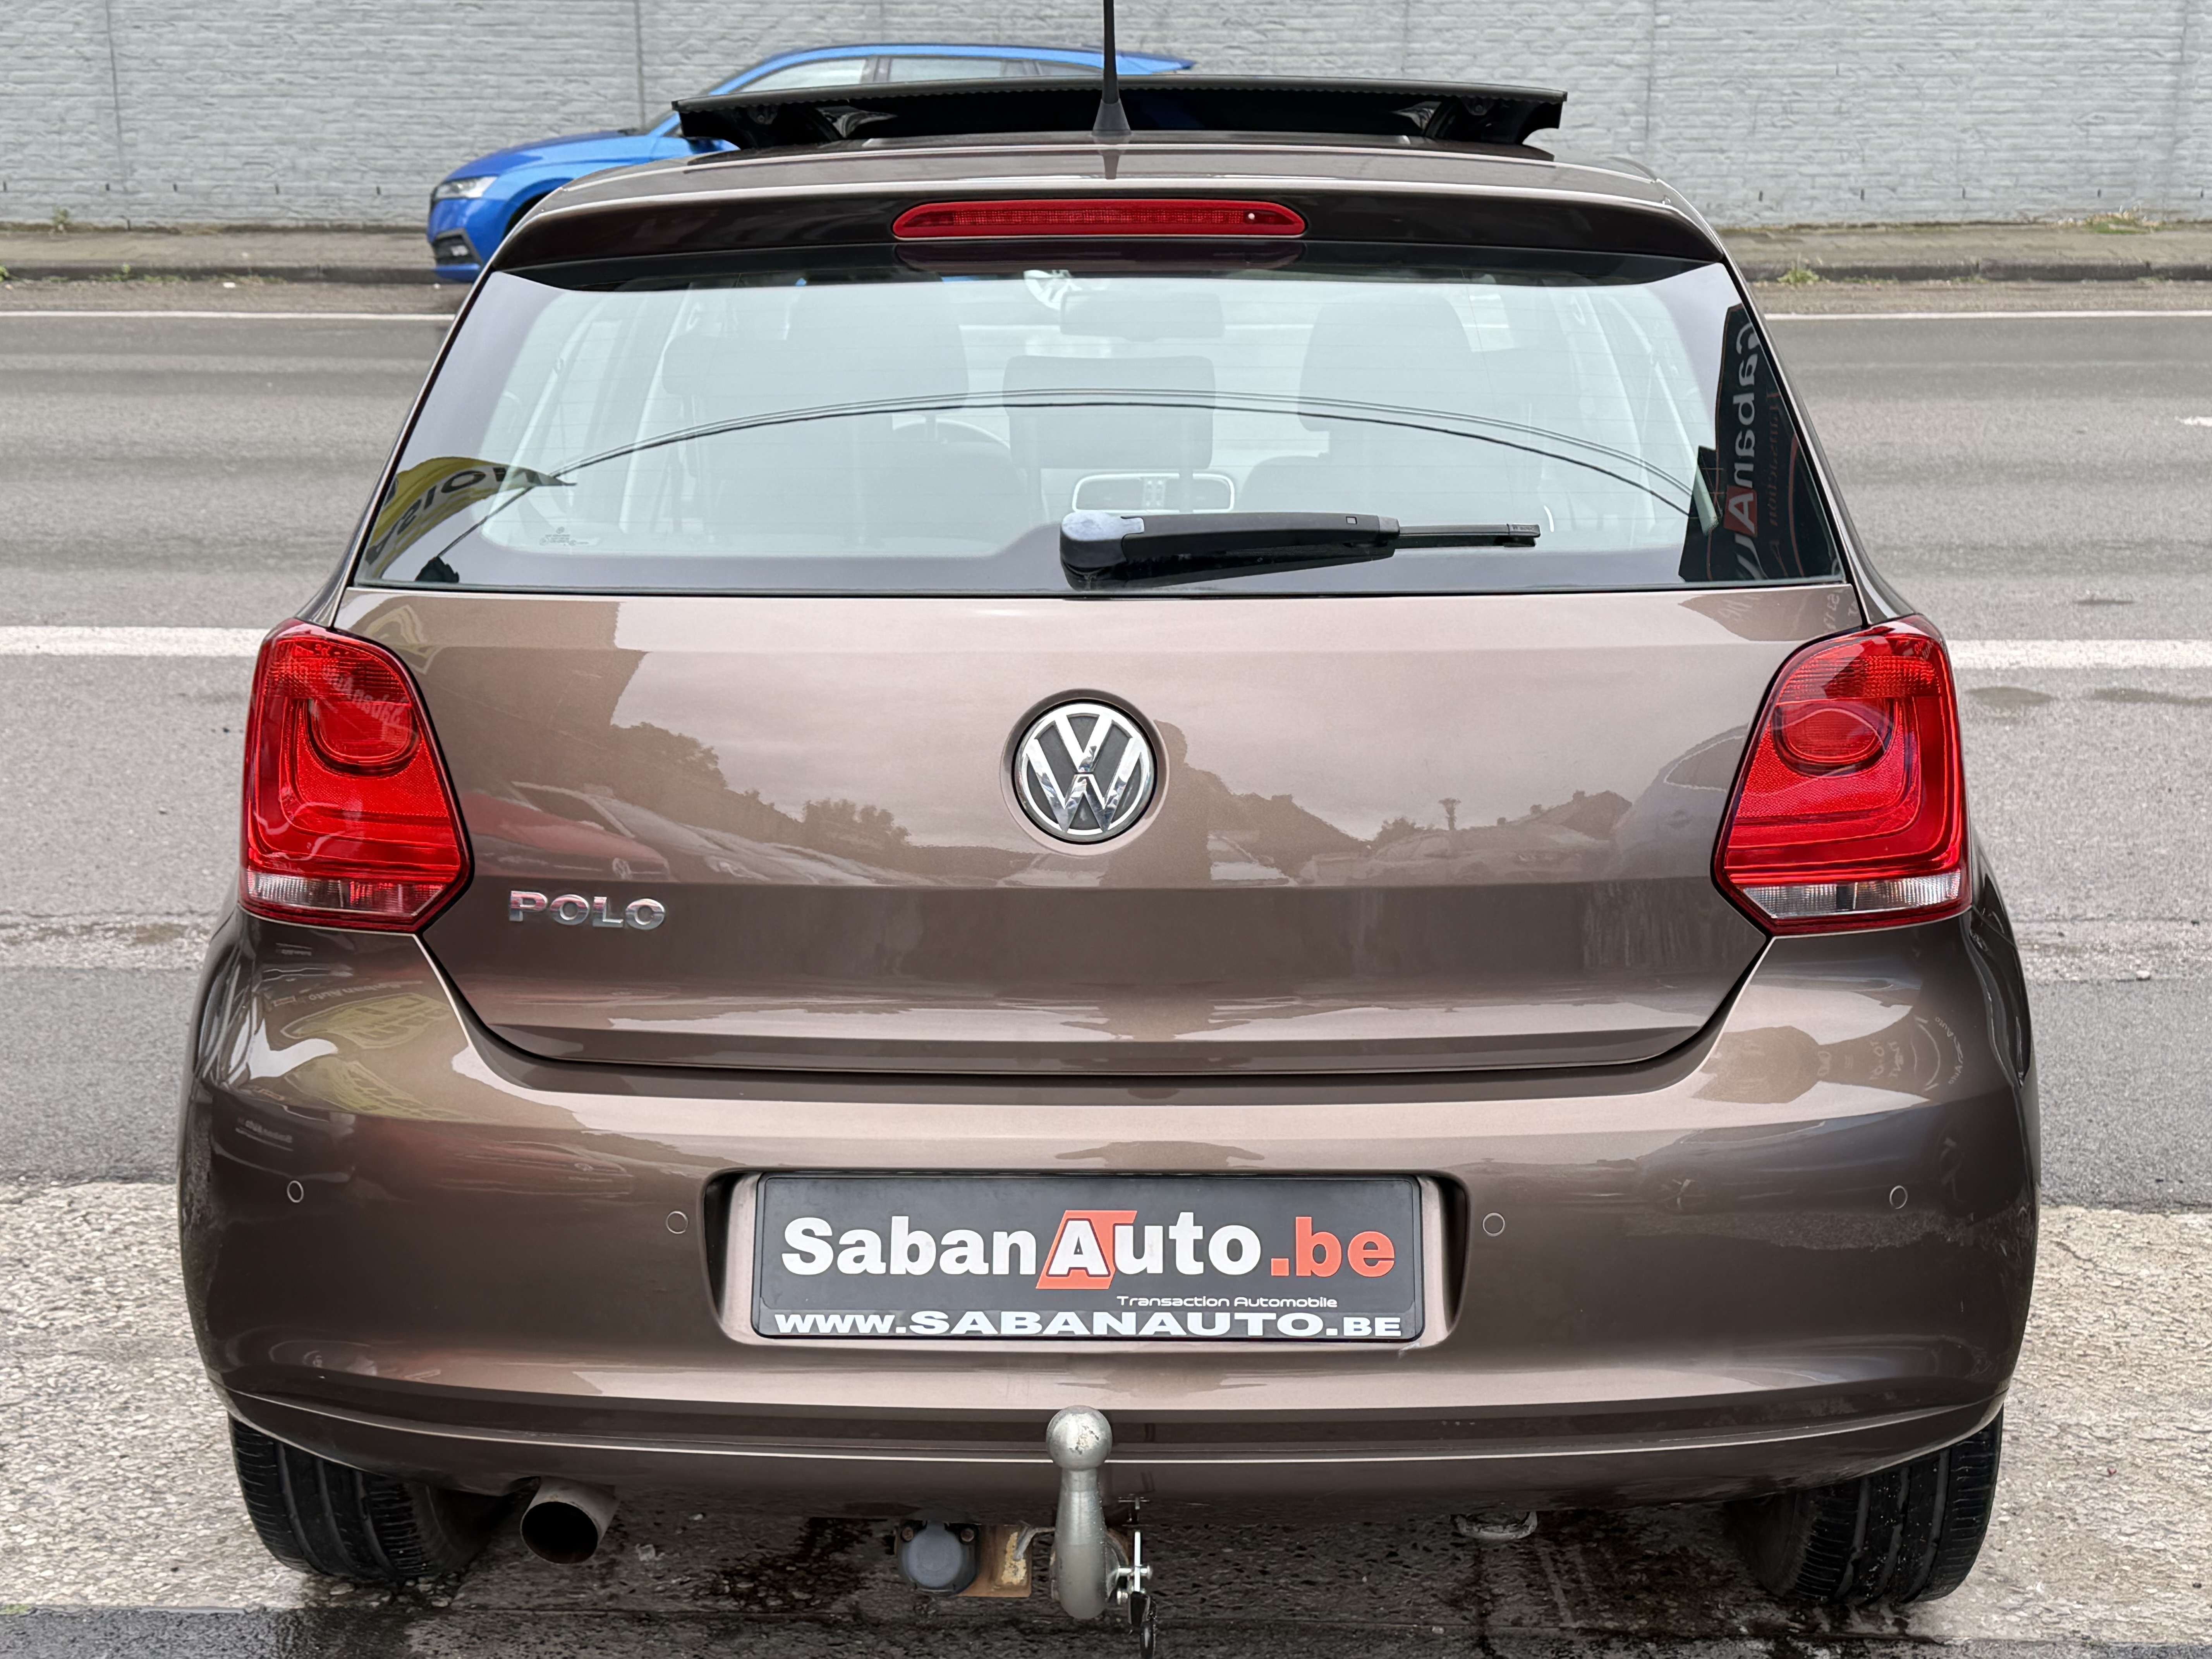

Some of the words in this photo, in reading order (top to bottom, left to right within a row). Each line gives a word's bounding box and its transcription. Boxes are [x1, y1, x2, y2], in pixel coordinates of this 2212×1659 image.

[509, 891, 665, 930] POLO
[1116, 1295, 1230, 1307] Transaction
[1234, 1297, 1338, 1308] Automobile
[775, 1310, 1401, 1336] www.SABANAUTO.BE
